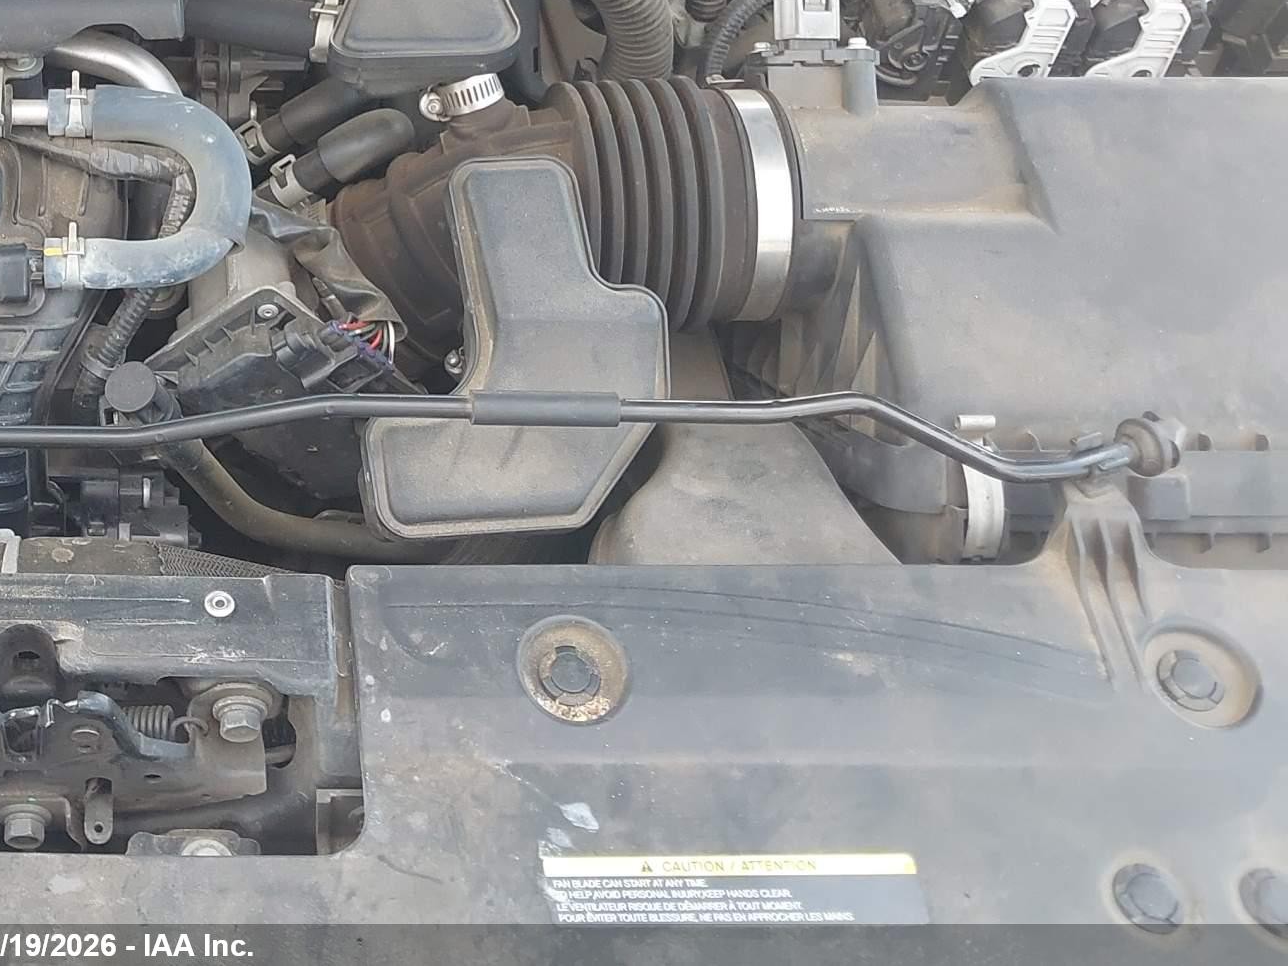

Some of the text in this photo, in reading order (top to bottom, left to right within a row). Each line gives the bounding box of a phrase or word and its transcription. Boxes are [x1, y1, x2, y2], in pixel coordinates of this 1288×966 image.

[662, 860, 725, 872] CAUTION
[741, 860, 817, 871] ATTENTION
[552, 879, 572, 889] FAN
[572, 879, 602, 889] BLADE
[602, 879, 623, 889] CAN
[623, 879, 652, 888] START
[652, 879, 665, 888] AT
[664, 879, 684, 888] ANY
[568, 890, 593, 899] HELP
[621, 890, 671, 899] PERSONAL
[725, 889, 760, 898] HANDS
[627, 902, 663, 911] RISQUE
[662, 902, 678, 911] DE
[735, 901, 761, 911] TOUT
[616, 913, 649, 923] TOUTE
[712, 913, 733, 922] PAS
